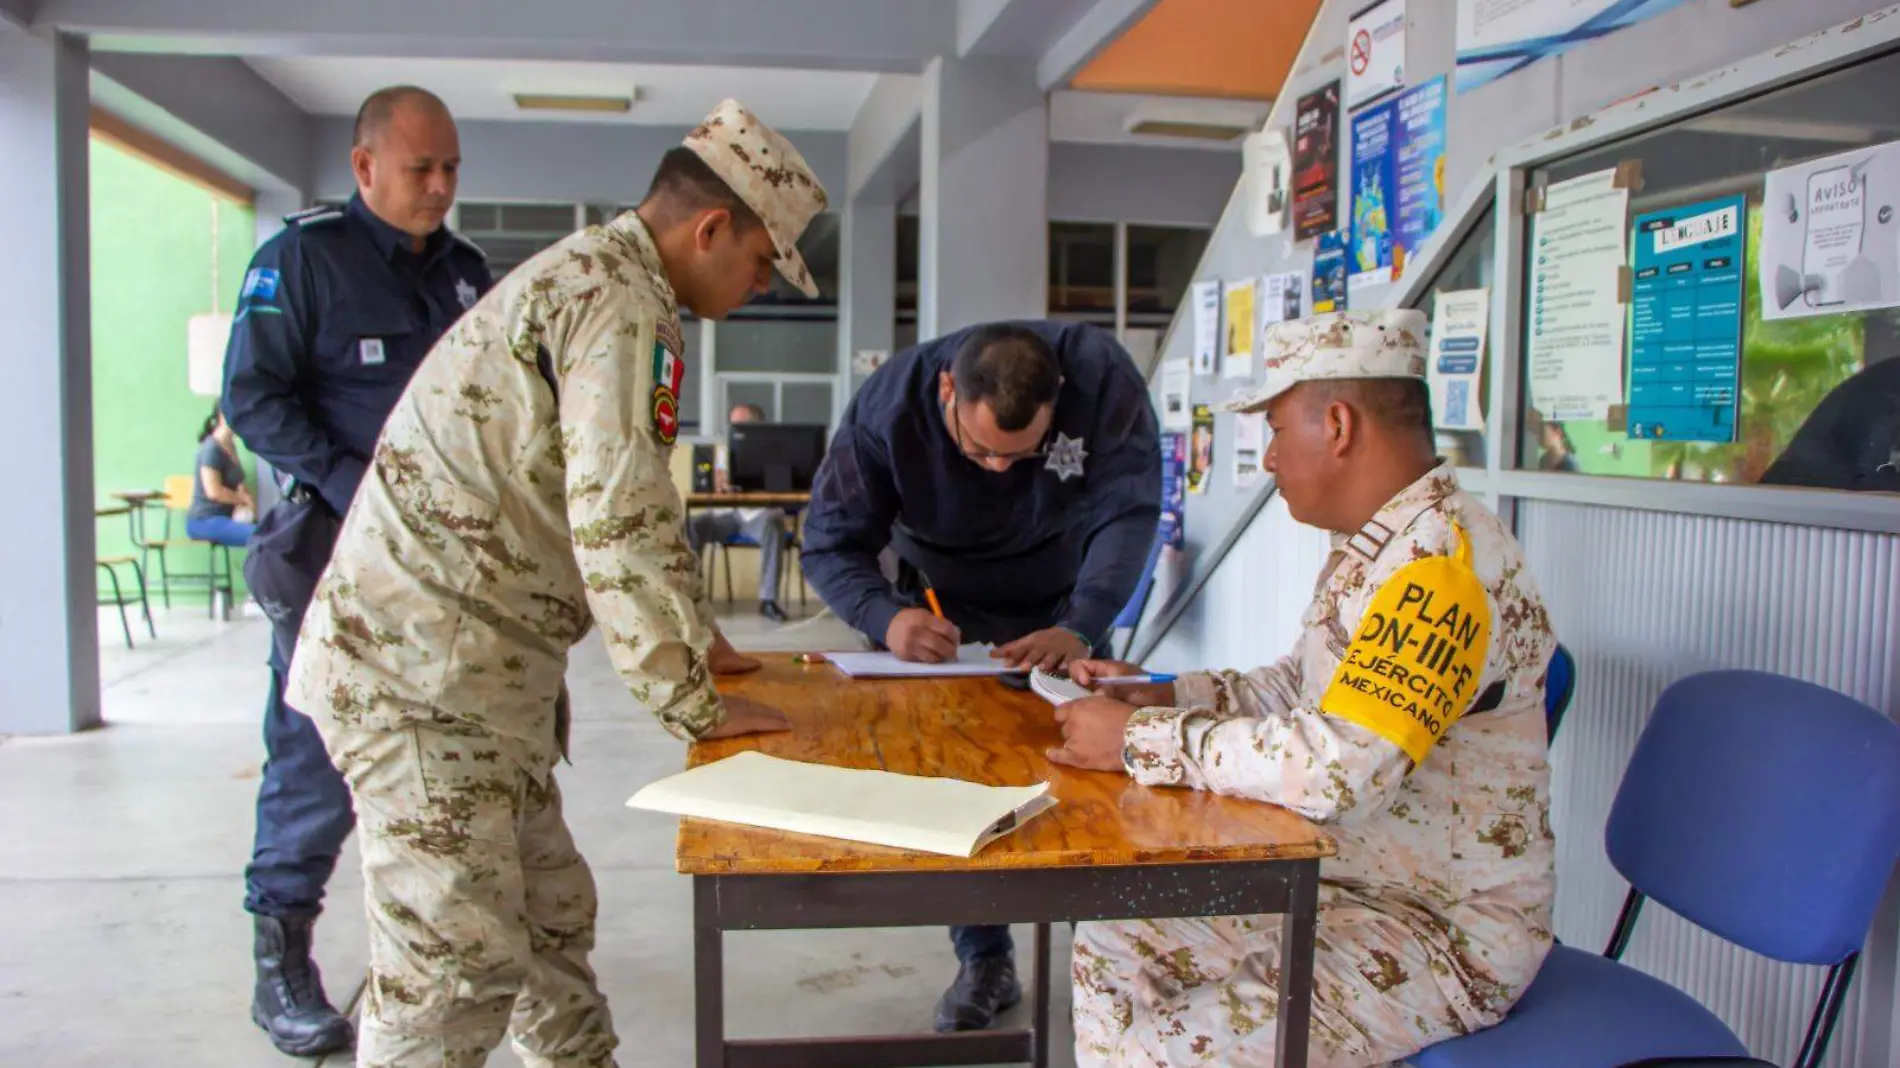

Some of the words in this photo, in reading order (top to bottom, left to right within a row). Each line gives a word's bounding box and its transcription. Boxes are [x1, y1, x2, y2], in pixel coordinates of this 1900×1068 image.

[1815, 180, 1857, 203] AVISO
[1396, 583, 1480, 650] PLAN
[1340, 672, 1441, 735] MEXICANO
[1345, 649, 1454, 717] EJÉRCITO
